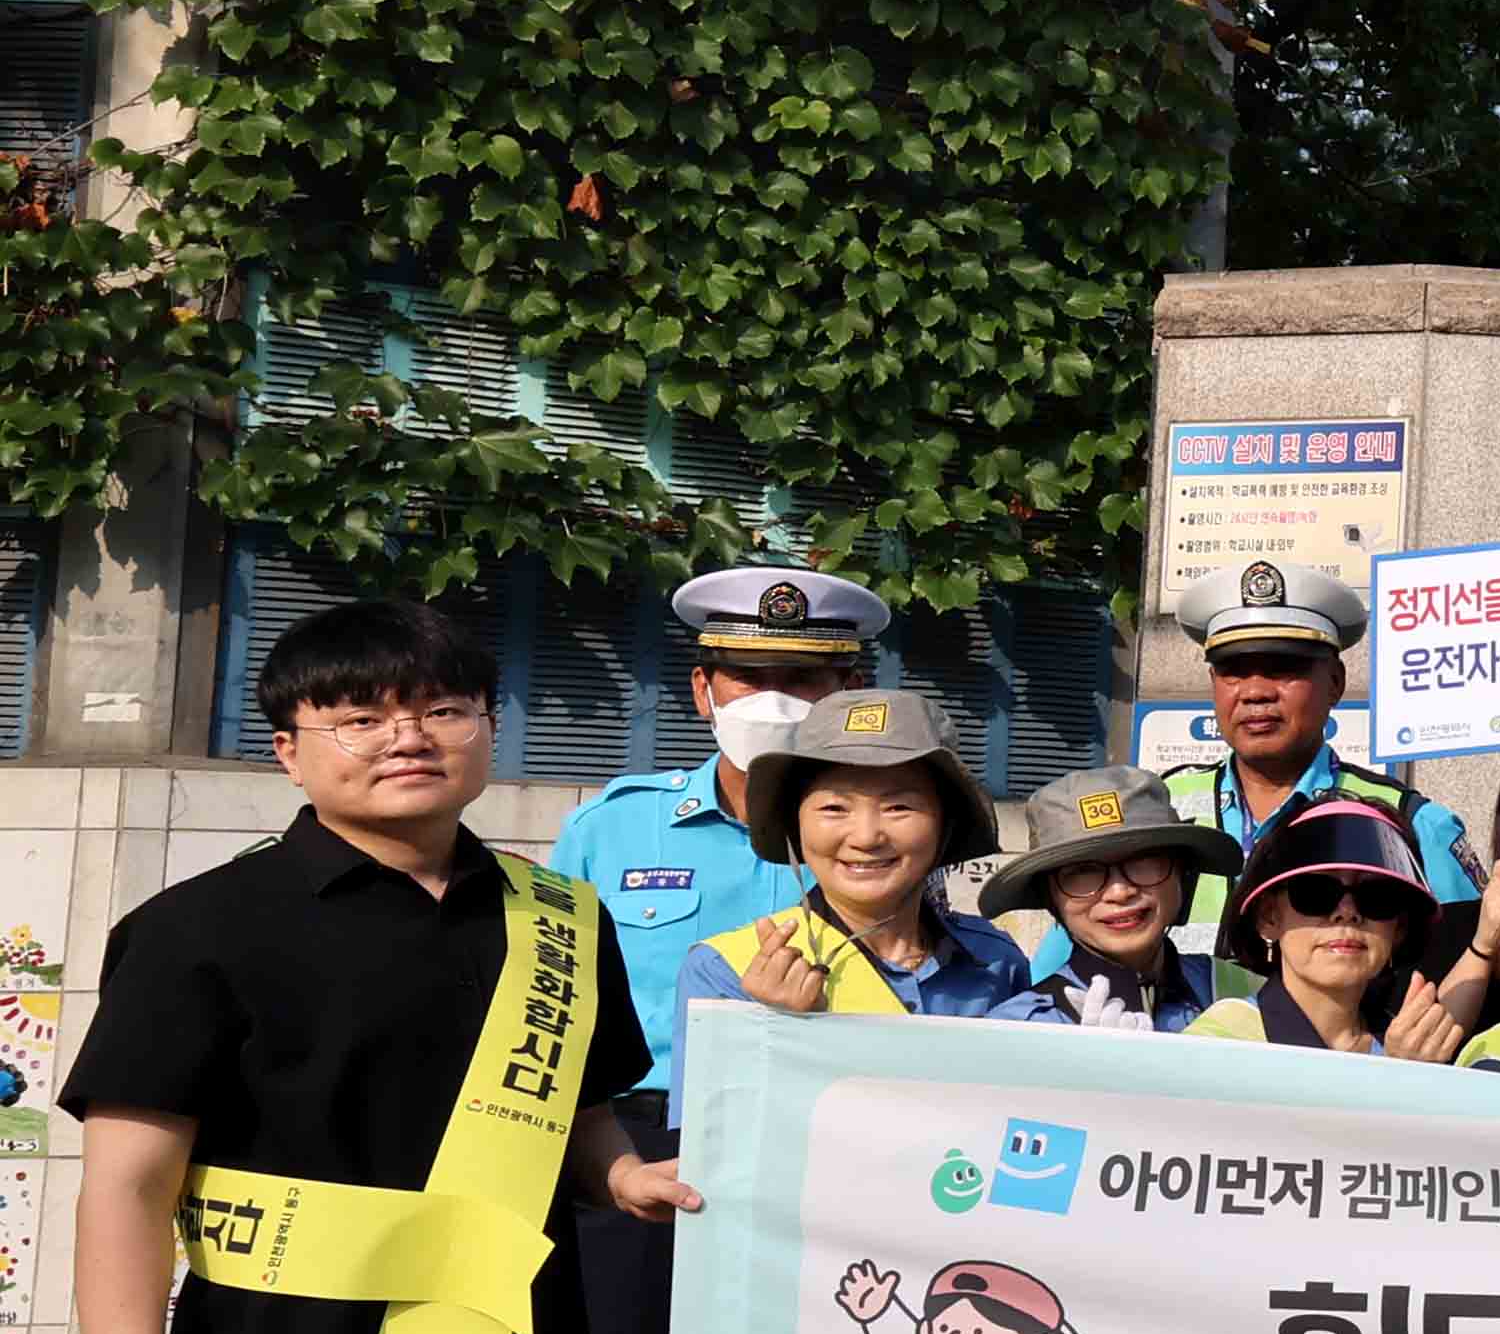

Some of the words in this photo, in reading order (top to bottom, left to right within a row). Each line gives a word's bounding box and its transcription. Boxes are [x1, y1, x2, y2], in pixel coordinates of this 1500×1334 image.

[1179, 435, 1228, 464] CCTV
[1232, 434, 1273, 464] 설치
[1279, 432, 1301, 464] 및
[1306, 431, 1349, 463] 운영
[1354, 430, 1397, 462] 안내
[502, 916, 581, 1103] 생활화합시다
[1098, 1153, 1323, 1220] 아이먼저
